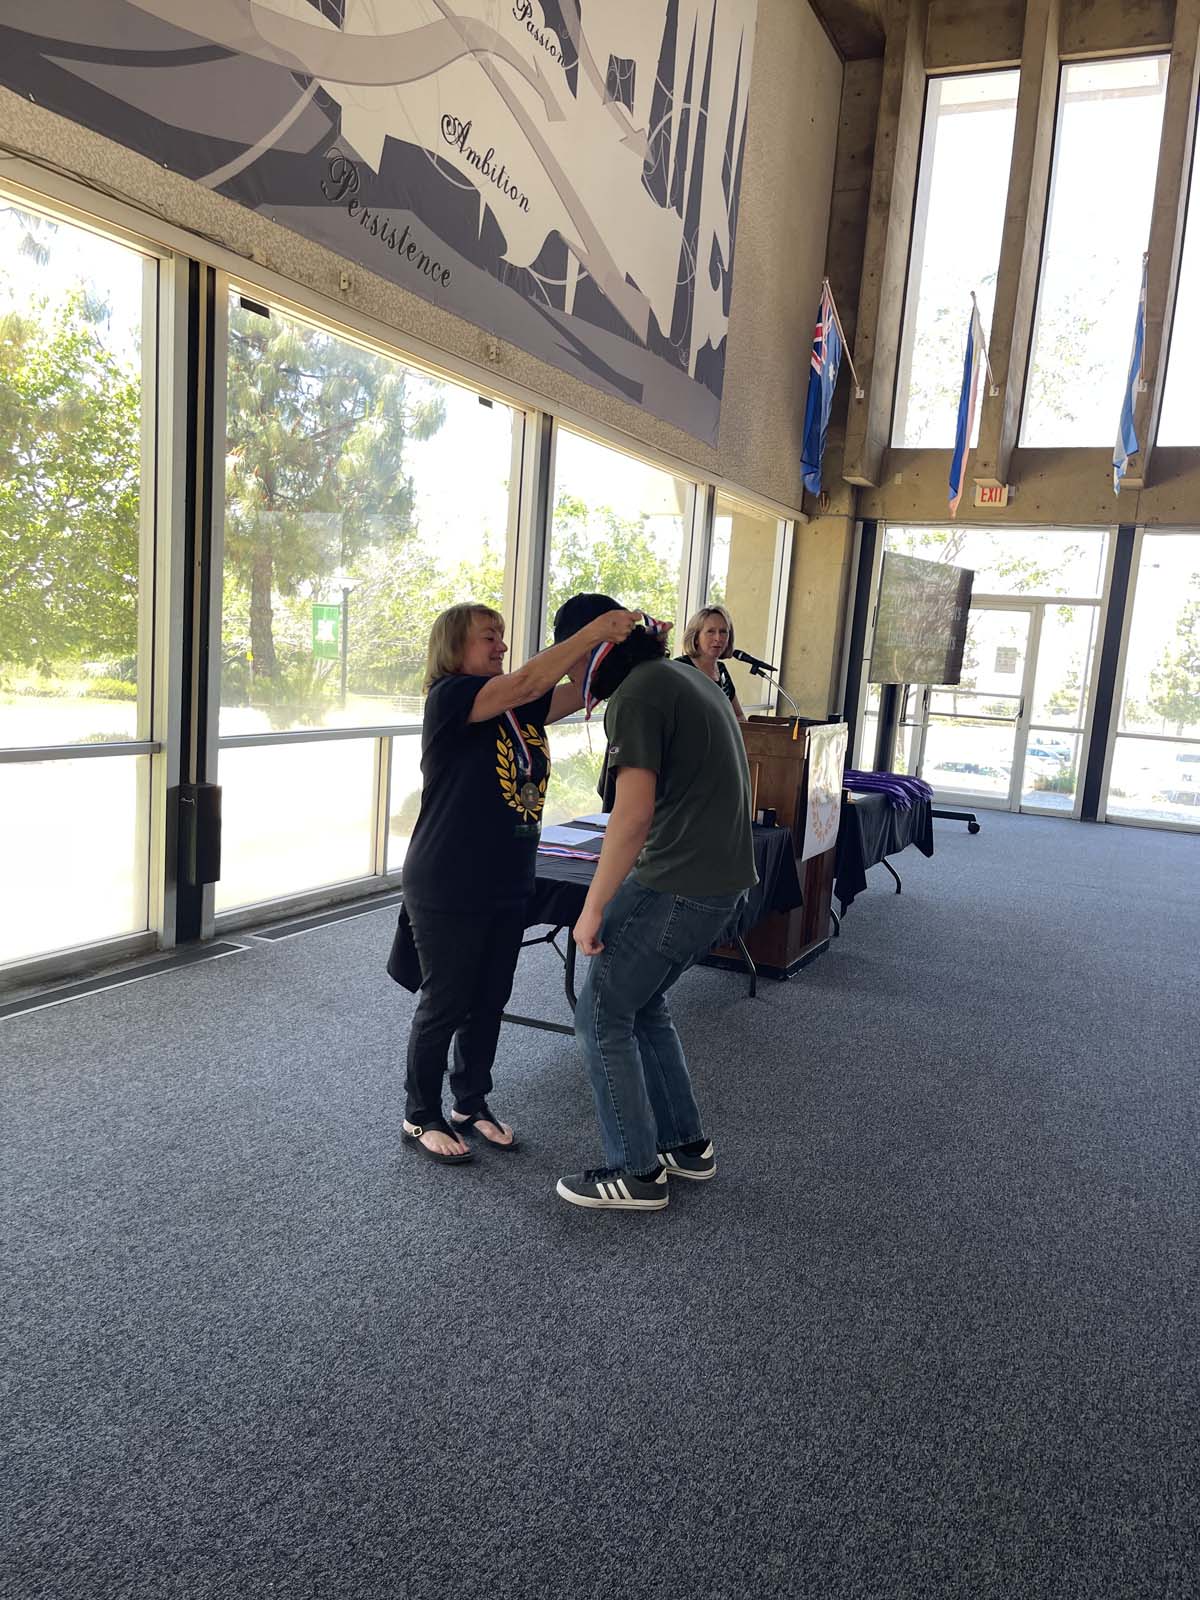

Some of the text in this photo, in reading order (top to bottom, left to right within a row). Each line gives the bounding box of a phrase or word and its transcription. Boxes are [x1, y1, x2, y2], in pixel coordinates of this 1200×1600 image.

[512, 0, 565, 68] Passion
[441, 113, 530, 213] Ambition
[320, 150, 452, 288] Persistence
[980, 487, 1003, 503] EXIT
